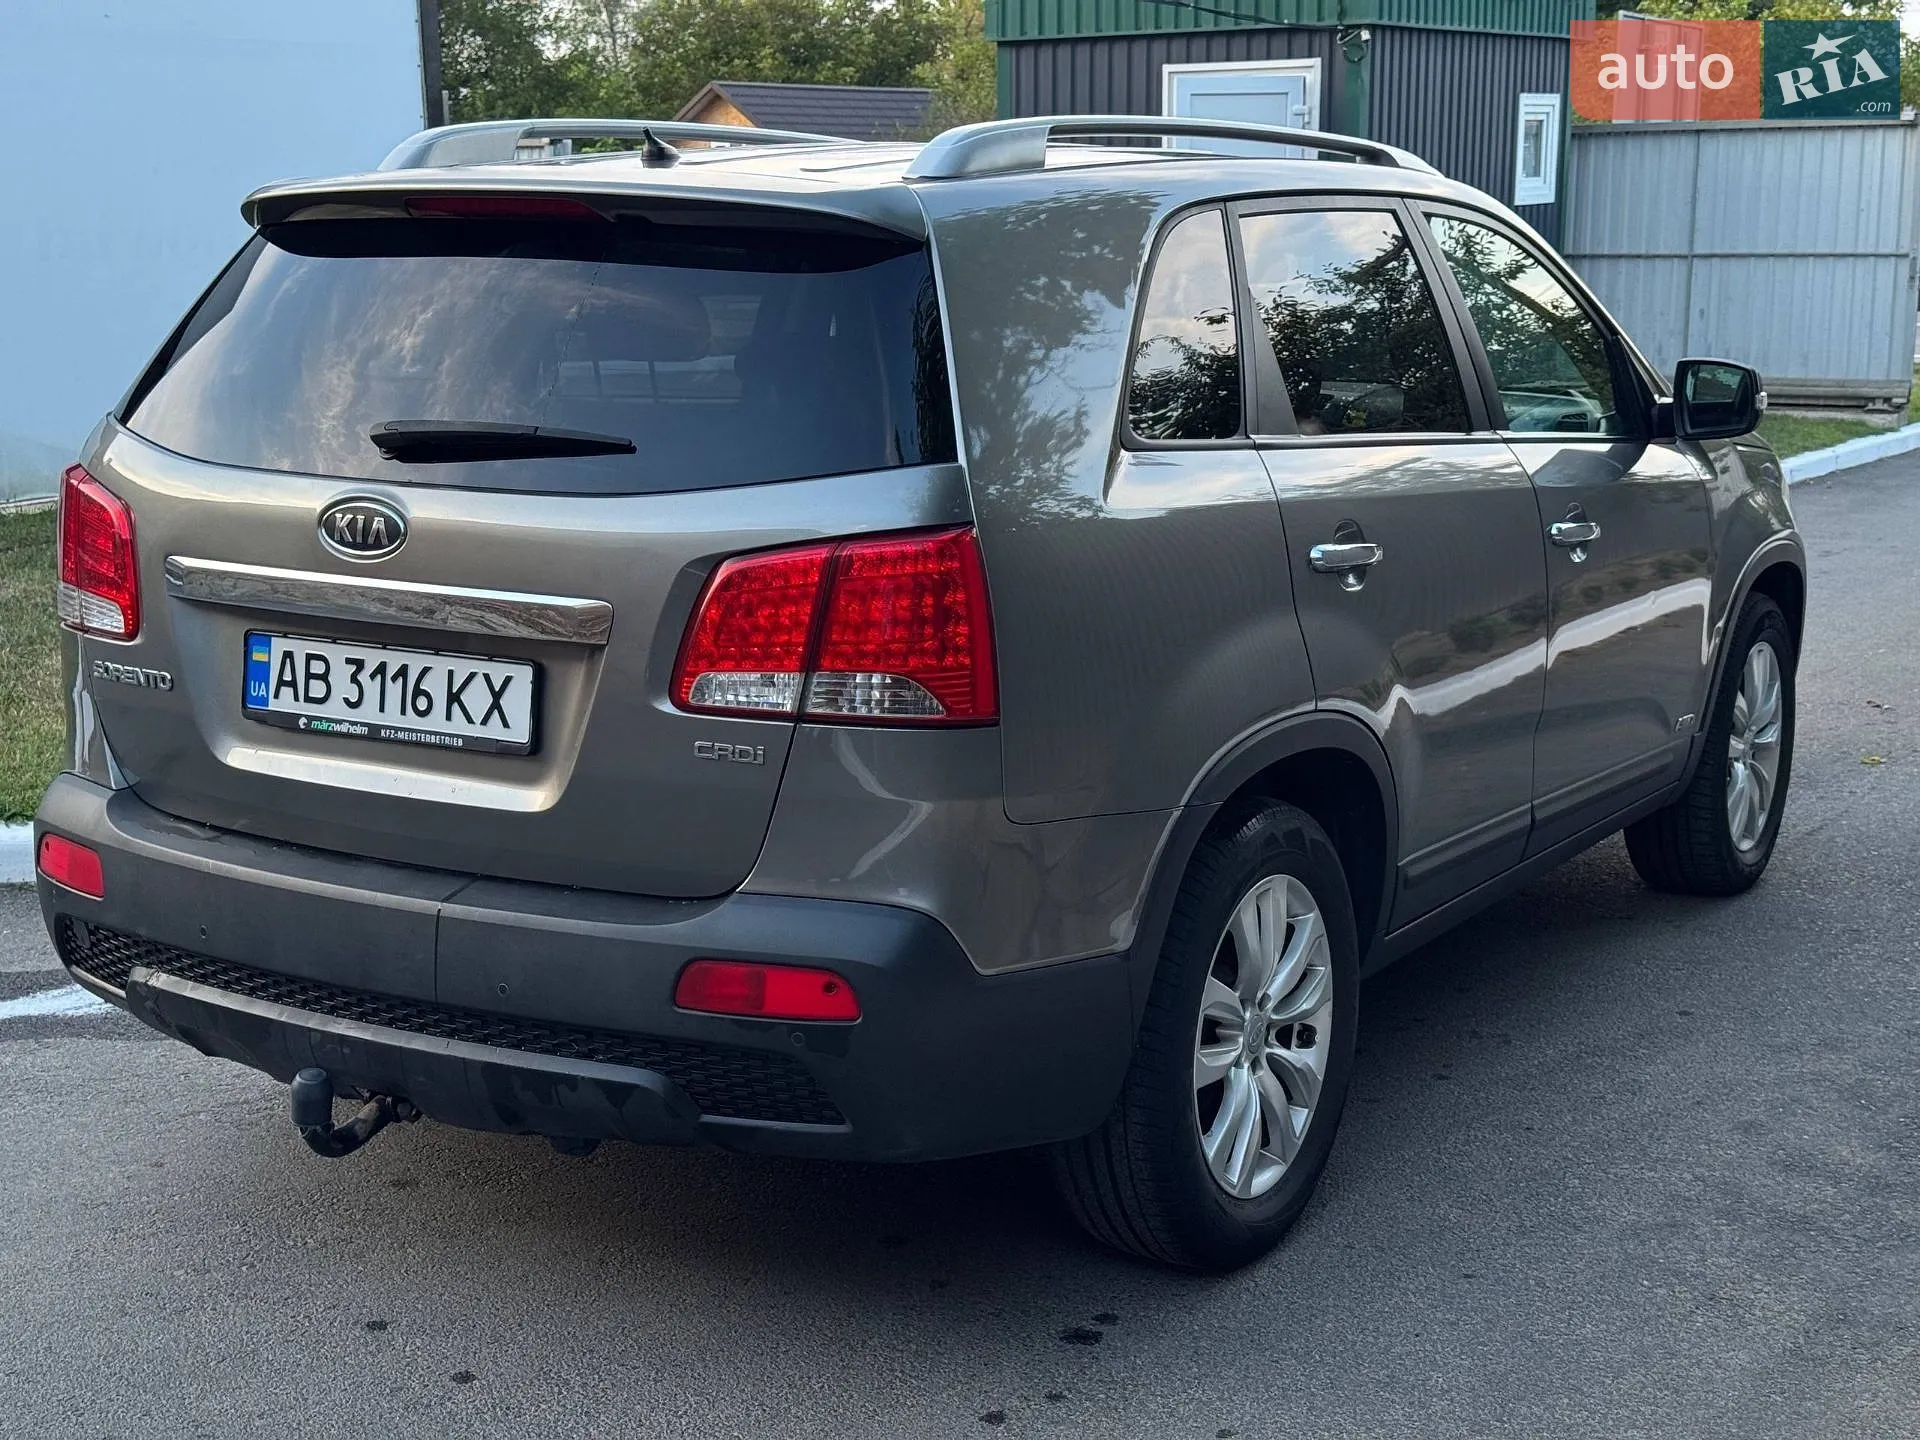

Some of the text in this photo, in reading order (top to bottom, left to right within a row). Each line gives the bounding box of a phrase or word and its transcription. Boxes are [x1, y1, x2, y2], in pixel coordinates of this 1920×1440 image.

[334, 513, 389, 545] KIA
[93, 660, 174, 691] SORENTO
[251, 681, 267, 699] UA
[273, 650, 514, 729] AB 3116 KX
[311, 719, 463, 747] märzwilhelm KFZ-MEISTERBETRIEB
[694, 741, 765, 765] CRDi
